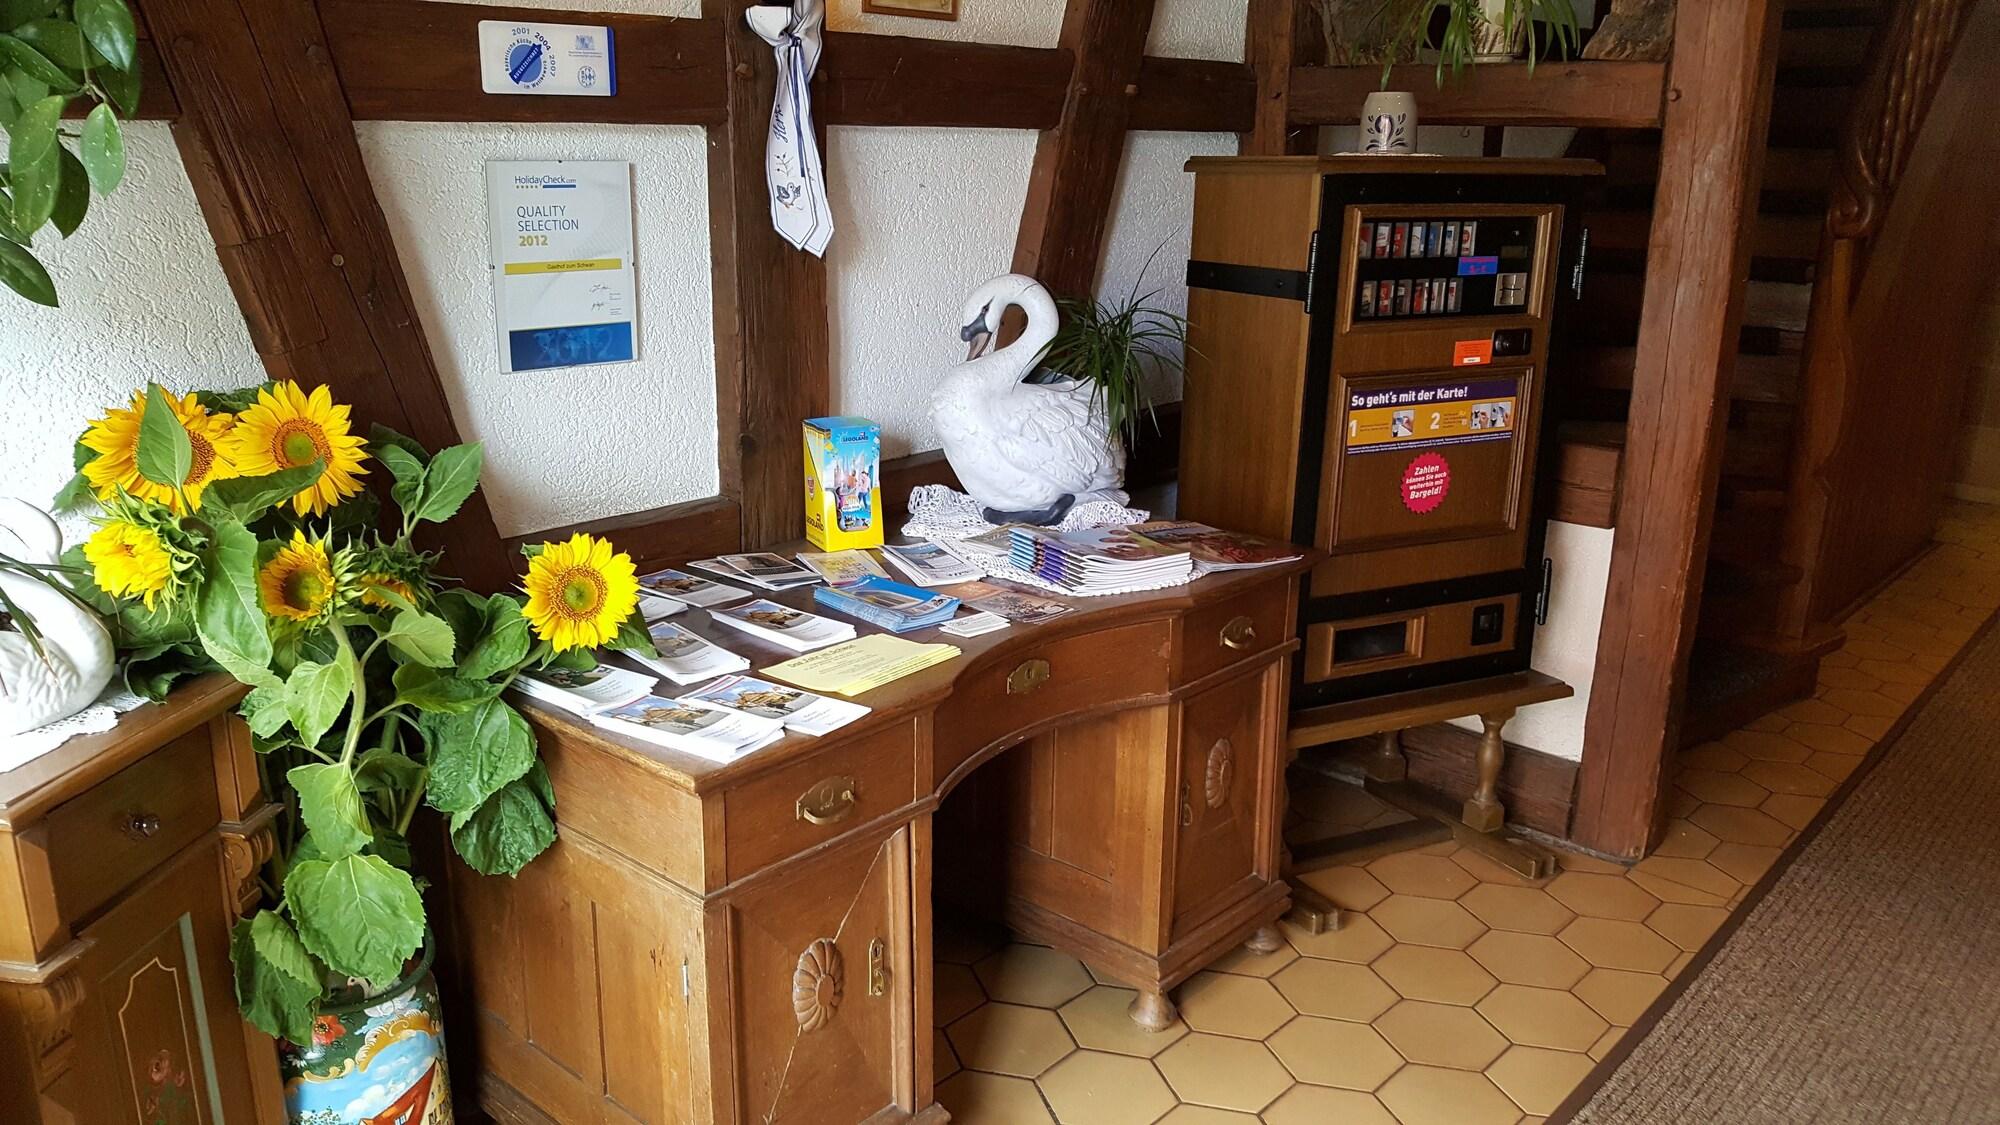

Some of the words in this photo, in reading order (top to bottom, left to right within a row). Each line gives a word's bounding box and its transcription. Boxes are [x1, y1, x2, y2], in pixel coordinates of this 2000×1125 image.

[512, 27, 530, 36] 2001
[534, 32, 552, 51] 2004
[512, 47, 540, 80] AUSGEZEICHNET
[548, 54, 556, 78] 2007
[516, 206, 566, 218] QUALITY
[518, 220, 578, 232] SELECTION
[518, 235, 548, 246] 2012
[1351, 395, 1365, 406] So
[1366, 391, 1398, 408] geht's
[1398, 390, 1416, 402] mit
[1417, 390, 1435, 400] der
[1436, 386, 1468, 400] Karte!
[1430, 412, 1442, 430] 2
[1350, 420, 1358, 438] 1
[1414, 465, 1440, 476] Zahlen
[1406, 476, 1426, 484] können
[1409, 481, 1434, 490] weiterhin
[1410, 486, 1442, 500] Bargeld!
